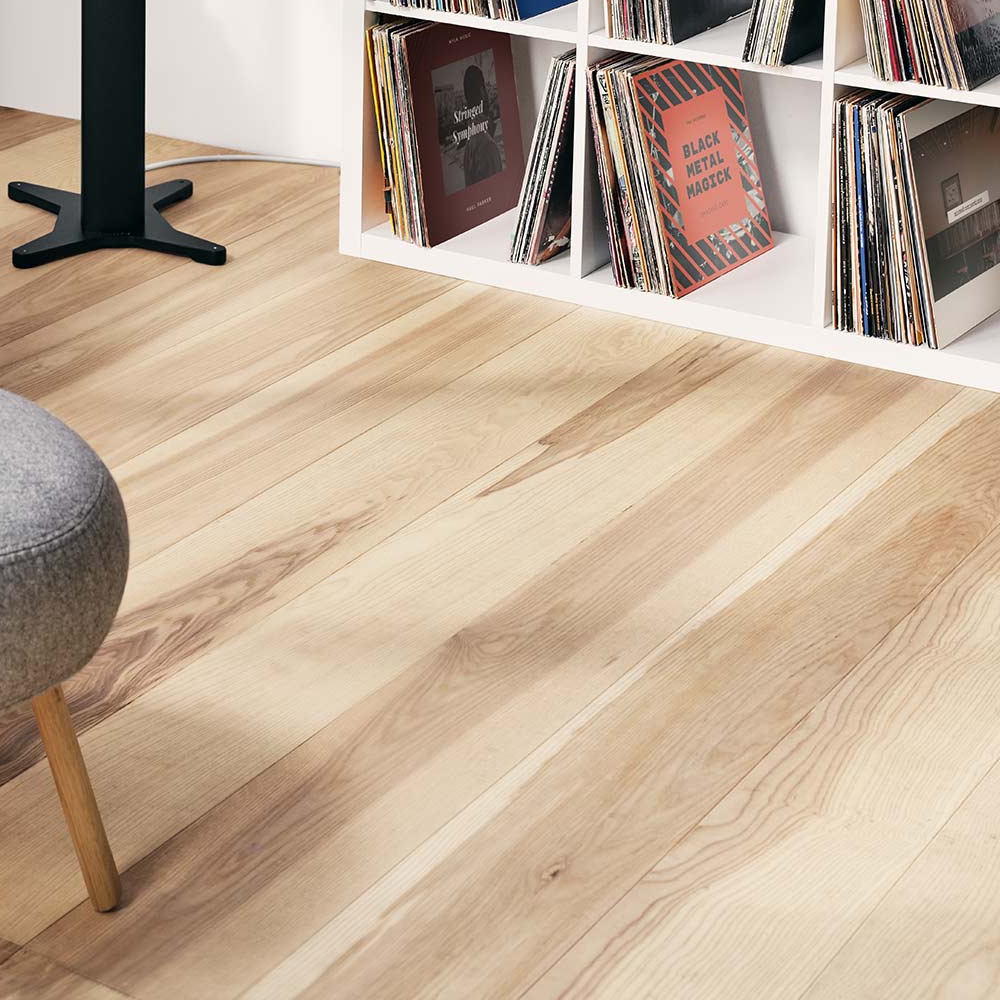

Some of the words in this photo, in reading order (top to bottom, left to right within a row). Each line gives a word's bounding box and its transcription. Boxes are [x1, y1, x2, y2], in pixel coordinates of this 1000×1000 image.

[453, 100, 484, 124] Stringed
[452, 120, 489, 145] Symphony
[682, 131, 721, 159] BLACK
[686, 151, 725, 178] METAL
[686, 167, 732, 200] MAGICK
